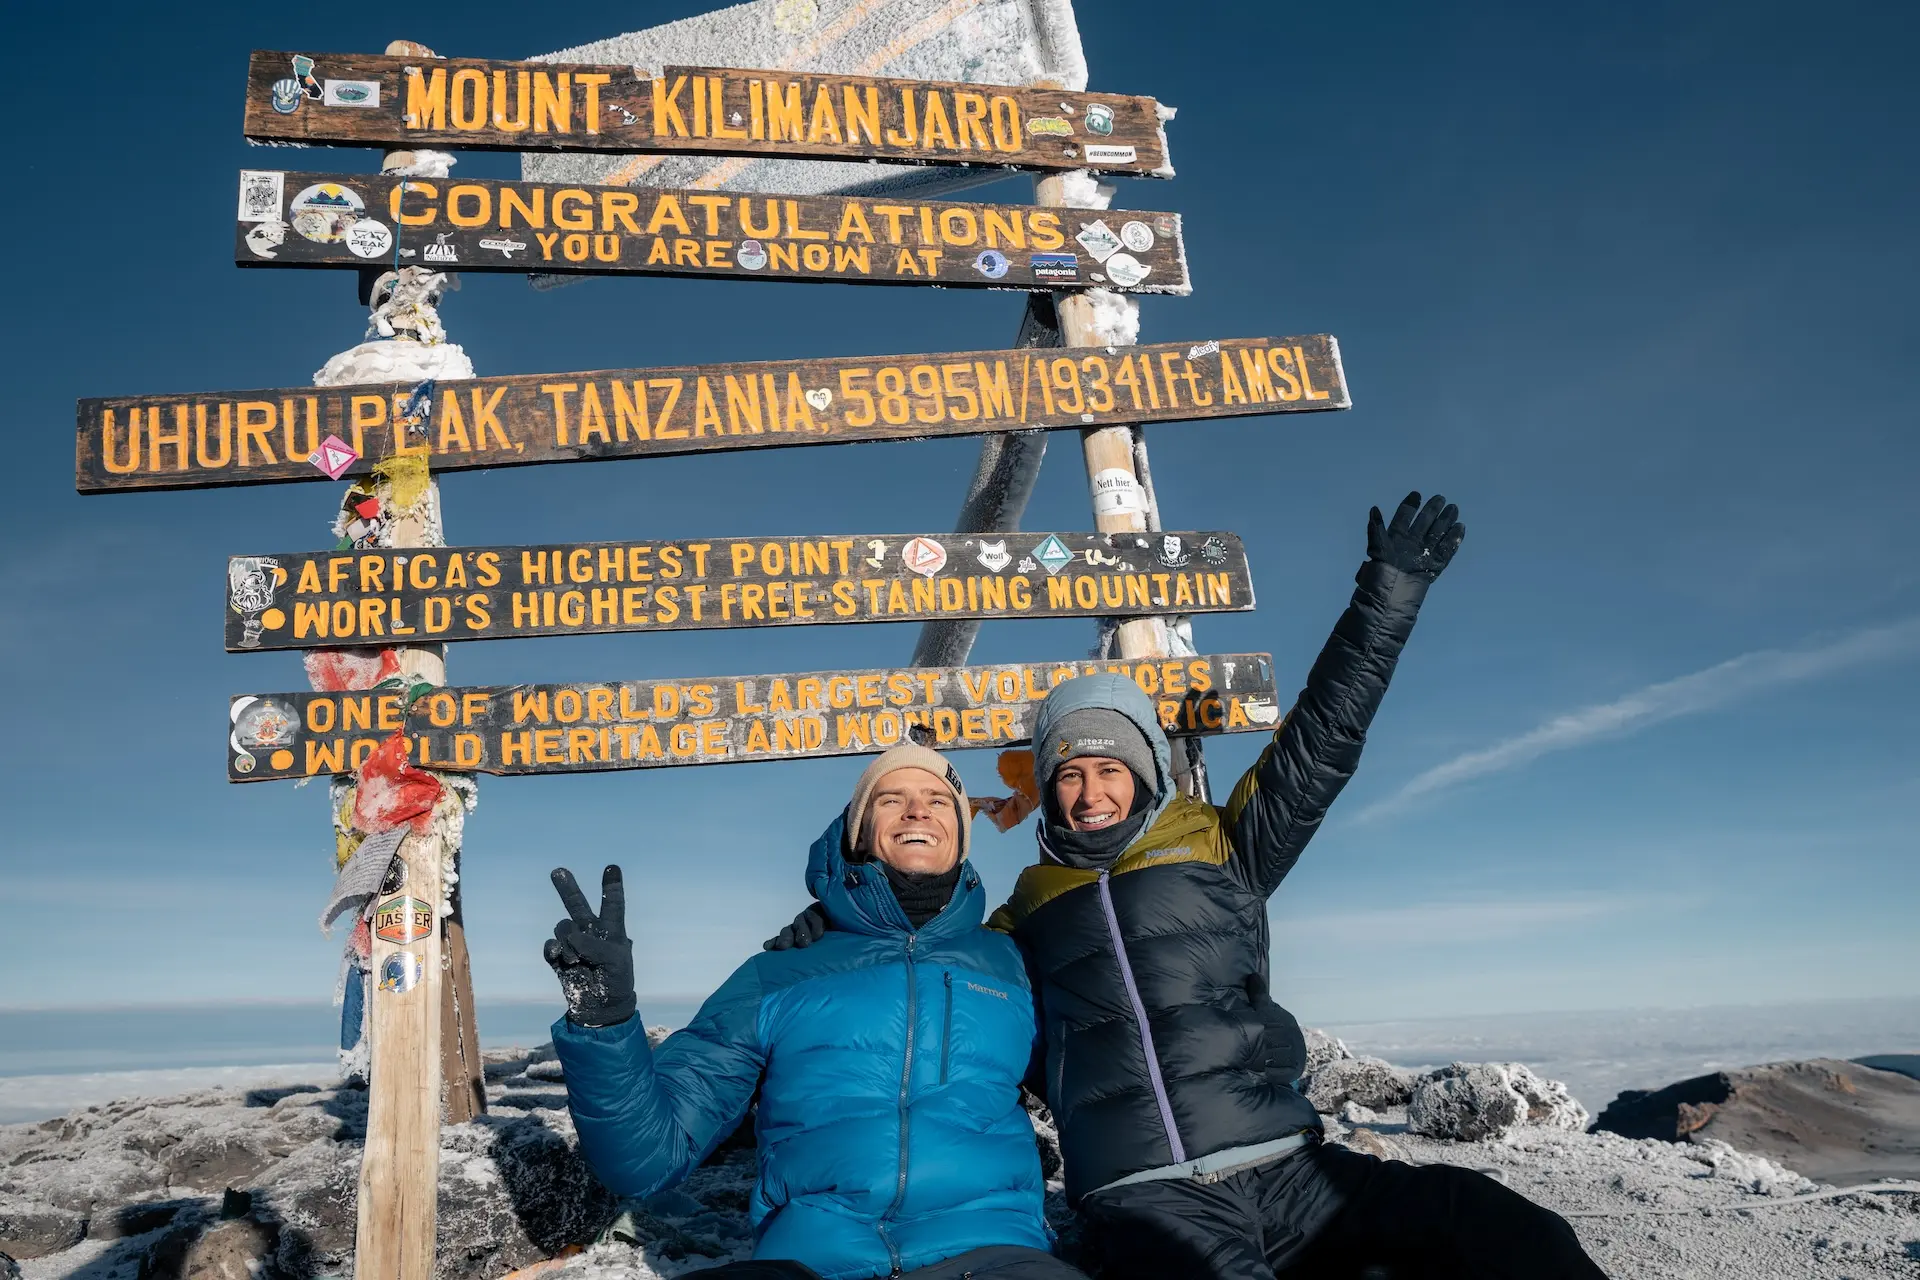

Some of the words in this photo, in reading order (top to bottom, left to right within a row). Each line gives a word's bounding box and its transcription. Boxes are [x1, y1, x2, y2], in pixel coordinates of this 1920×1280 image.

[404, 66, 611, 135] MOUNT
[651, 74, 1024, 153] KILIMANJARO
[389, 181, 1066, 251] CONGRATULATIONS
[350, 239, 386, 249] PEAK
[536, 231, 620, 263] YOU
[648, 236, 733, 269] ARE
[768, 242, 870, 275] NOW
[896, 247, 943, 276] AT
[1035, 268, 1077, 276] patagonia
[102, 395, 319, 474] UHURU
[351, 386, 525, 460] PEAK,
[541, 370, 832, 447] TANZANIA,
[1220, 347, 1330, 404] AMSL
[522, 544, 711, 584] HIGHEST
[730, 541, 854, 577] POINT
[512, 584, 706, 628] HIGHEST
[720, 576, 1032, 623] FREE-STANDING
[1047, 572, 1231, 610] MOUNTAIN
[307, 695, 405, 733] ONE
[429, 693, 490, 727] OF
[512, 684, 714, 723] WORLD'S
[736, 672, 941, 715] LARGEST
[963, 660, 1212, 704] VOLOES
[305, 732, 483, 777] WOLD
[502, 722, 728, 765] HERITAGE
[746, 717, 822, 753] AND
[378, 912, 431, 930] JASER
[967, 982, 1008, 1000] Marmot
